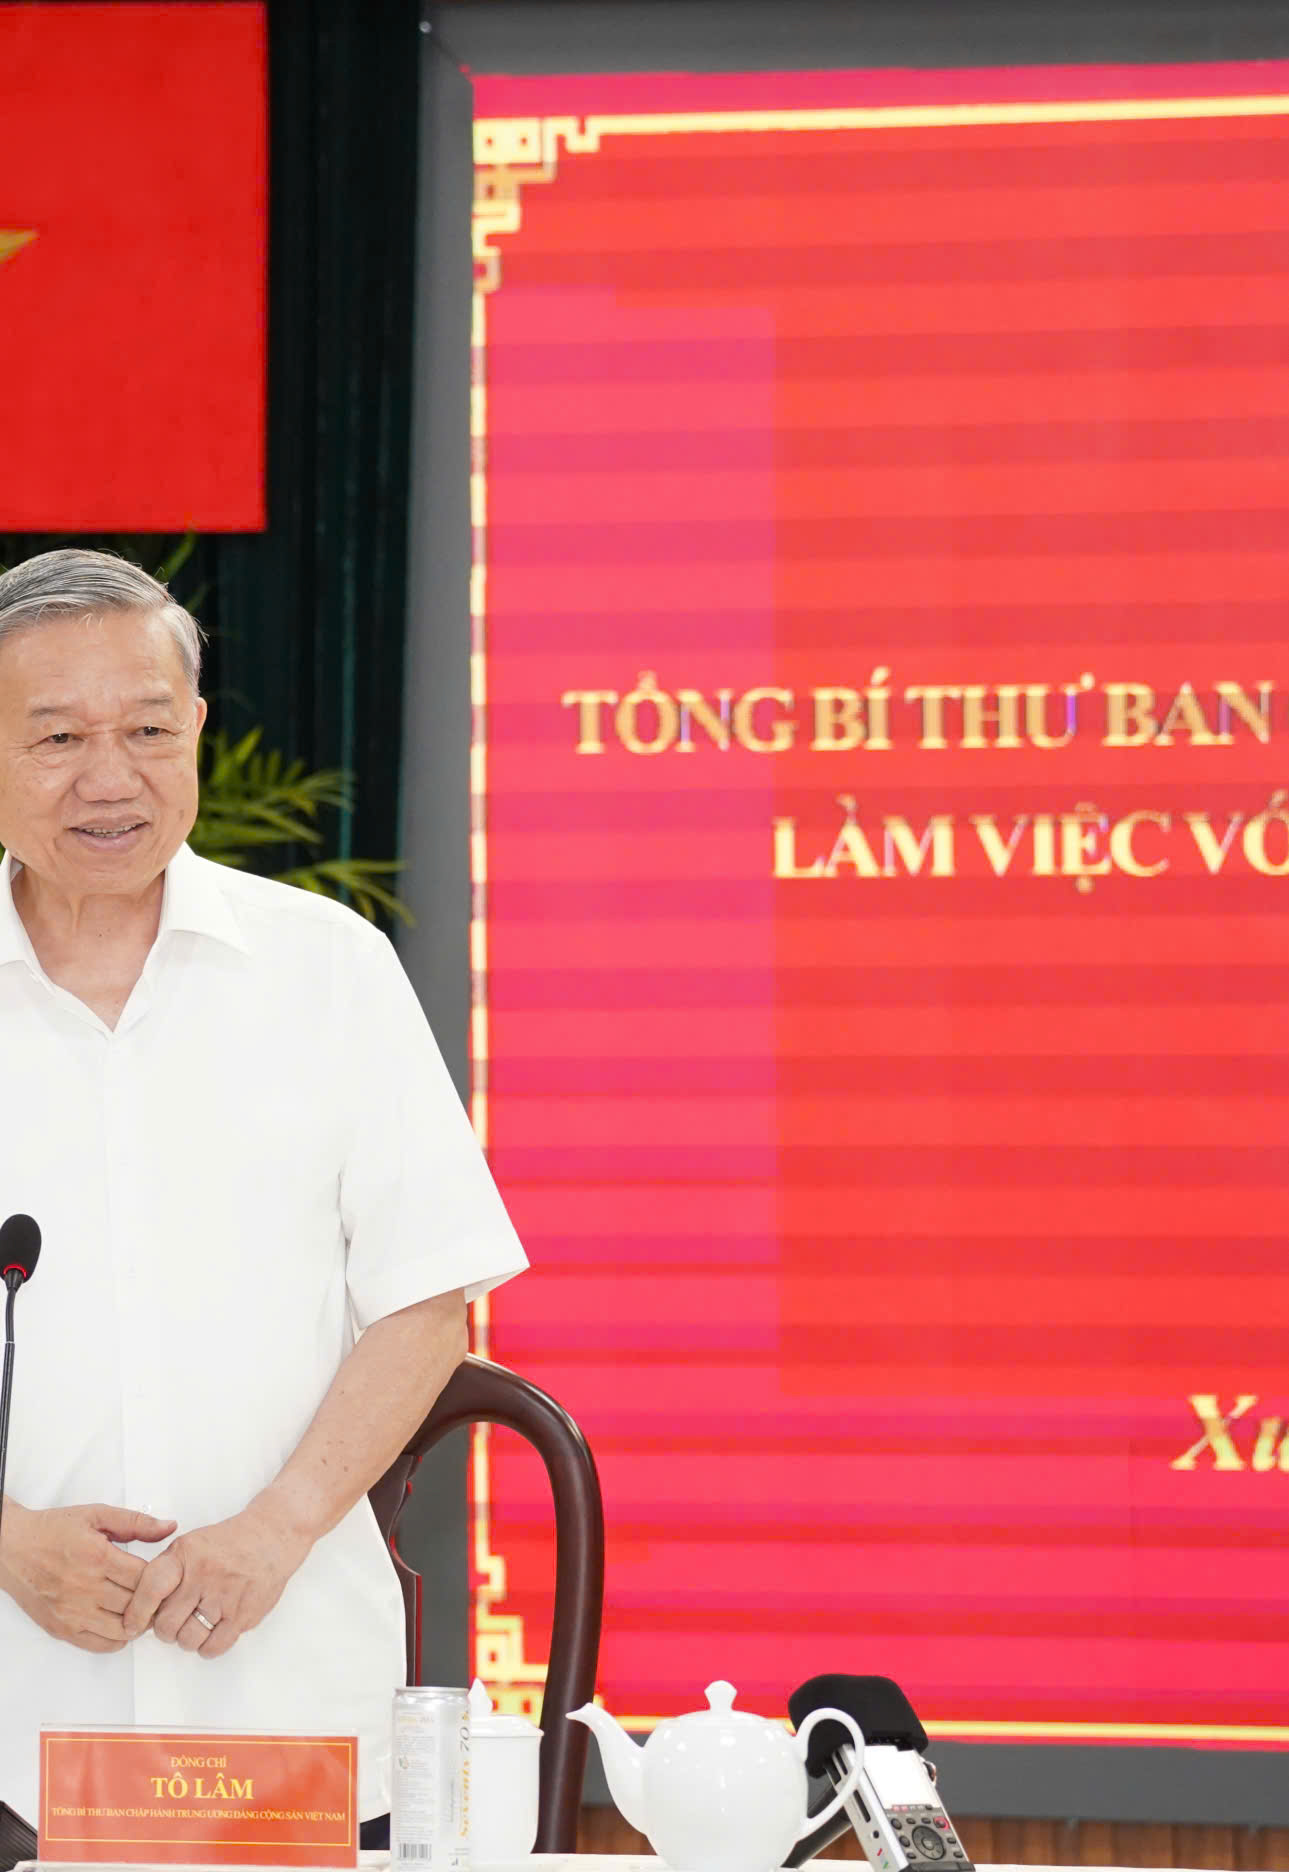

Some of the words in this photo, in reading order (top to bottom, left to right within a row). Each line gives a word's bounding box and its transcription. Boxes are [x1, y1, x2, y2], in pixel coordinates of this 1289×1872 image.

[562, 671, 798, 754] TỔNG
[813, 667, 892, 751] BÍ
[905, 673, 1094, 750] THƯ
[1101, 680, 1273, 747] BAN
[773, 795, 955, 878] LÀM
[972, 803, 1171, 893] VIỆC
[150, 1771, 189, 1799] TÔ
[194, 1772, 255, 1800] LÂM
